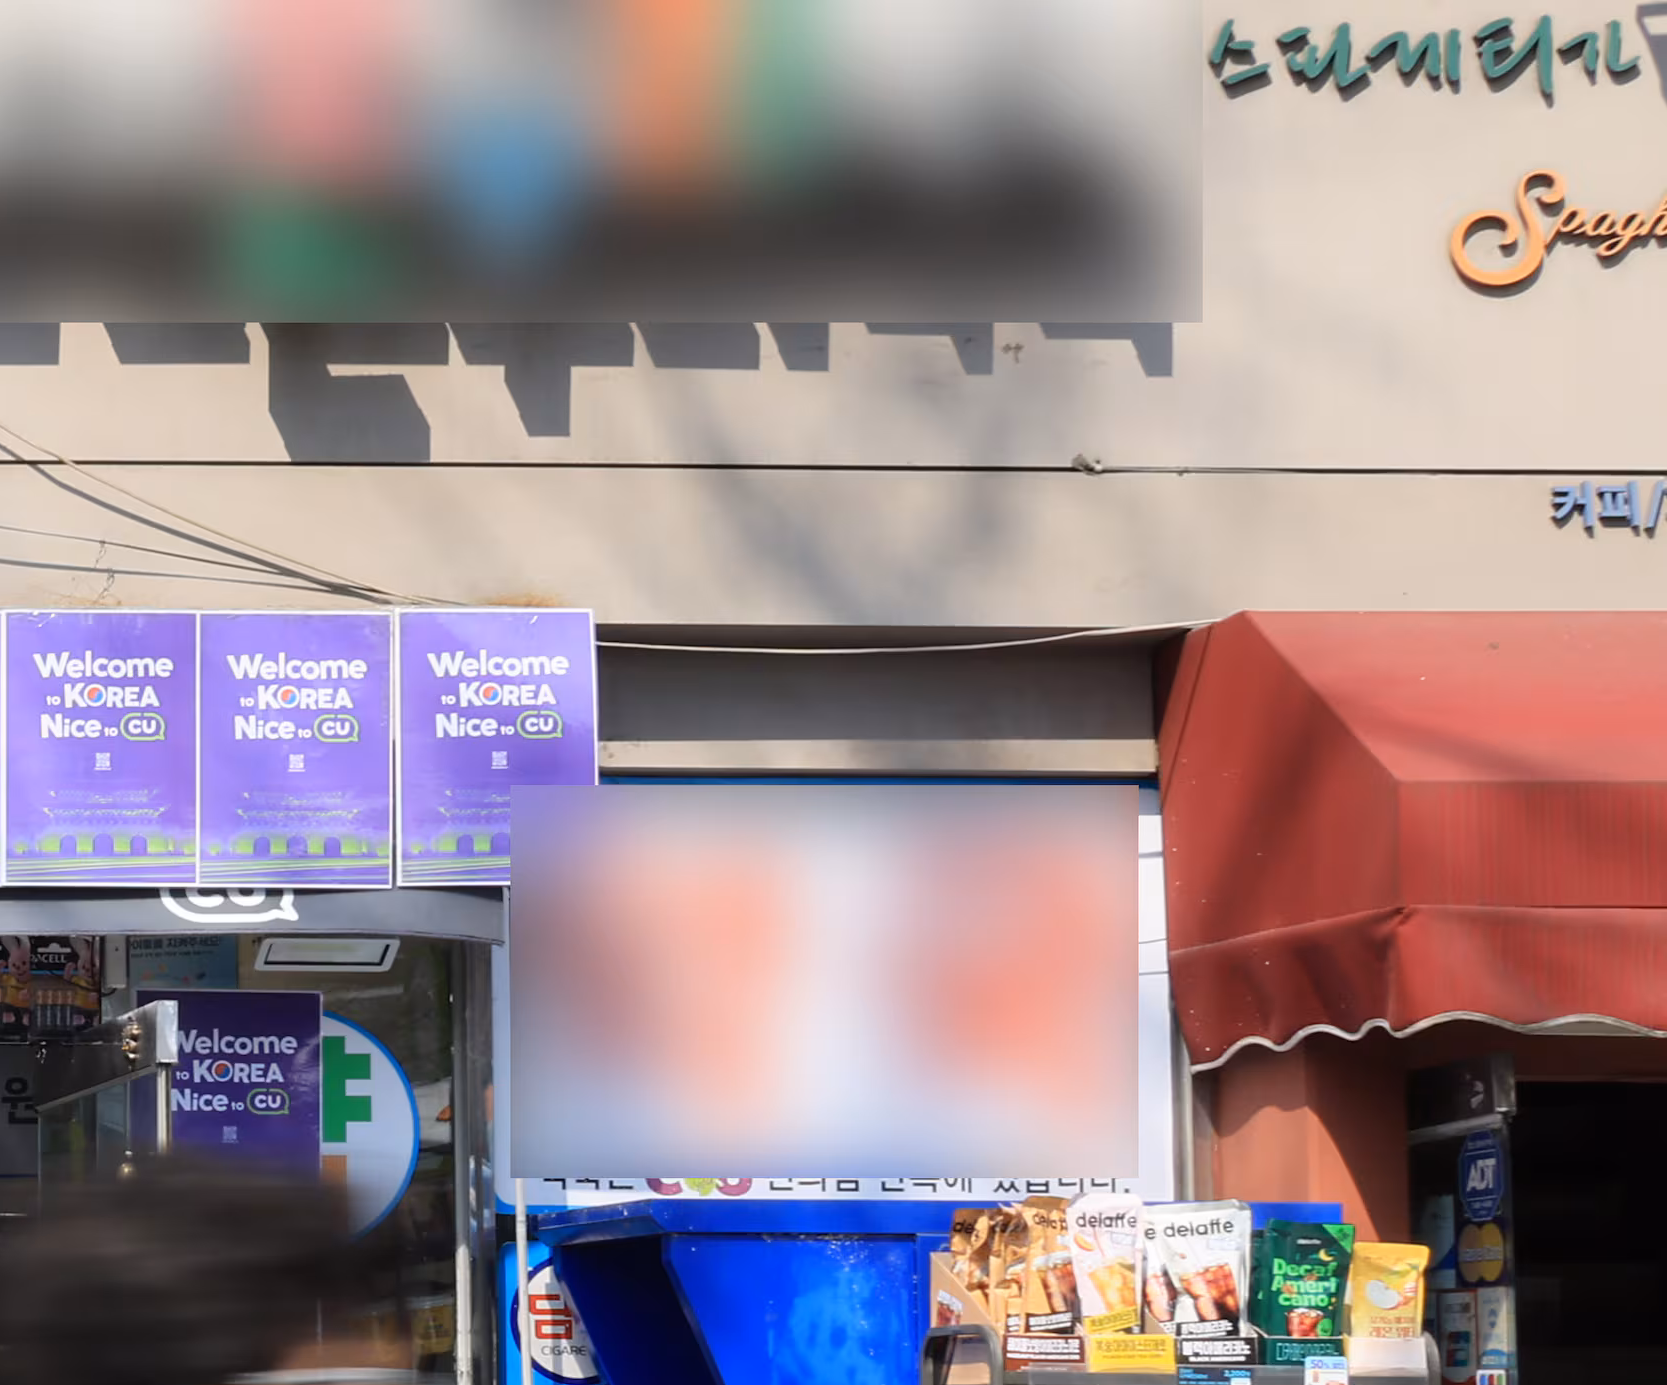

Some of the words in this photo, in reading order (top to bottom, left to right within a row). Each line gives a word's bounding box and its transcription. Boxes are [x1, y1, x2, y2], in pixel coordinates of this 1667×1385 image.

[33, 650, 174, 679] Welcome
[227, 652, 368, 681] Welcome
[428, 648, 569, 677] Welcome
[47, 695, 61, 706] to
[64, 683, 160, 708] KOREA
[241, 697, 255, 708] to
[258, 685, 354, 710] KOREA
[442, 693, 456, 704] to
[459, 681, 555, 706] KOREA
[41, 713, 102, 738] Nice
[235, 715, 296, 740] Nice
[436, 711, 497, 736] Nice
[178, 1028, 298, 1055] Welcome
[176, 1070, 190, 1080] to
[193, 1059, 285, 1083] KOREA
[171, 1088, 229, 1111] Nice
[231, 1102, 245, 1111] to
[1272, 1258, 1337, 1276] Decaf
[1271, 1276, 1337, 1294] Ameri
[1278, 1293, 1329, 1307] cano
